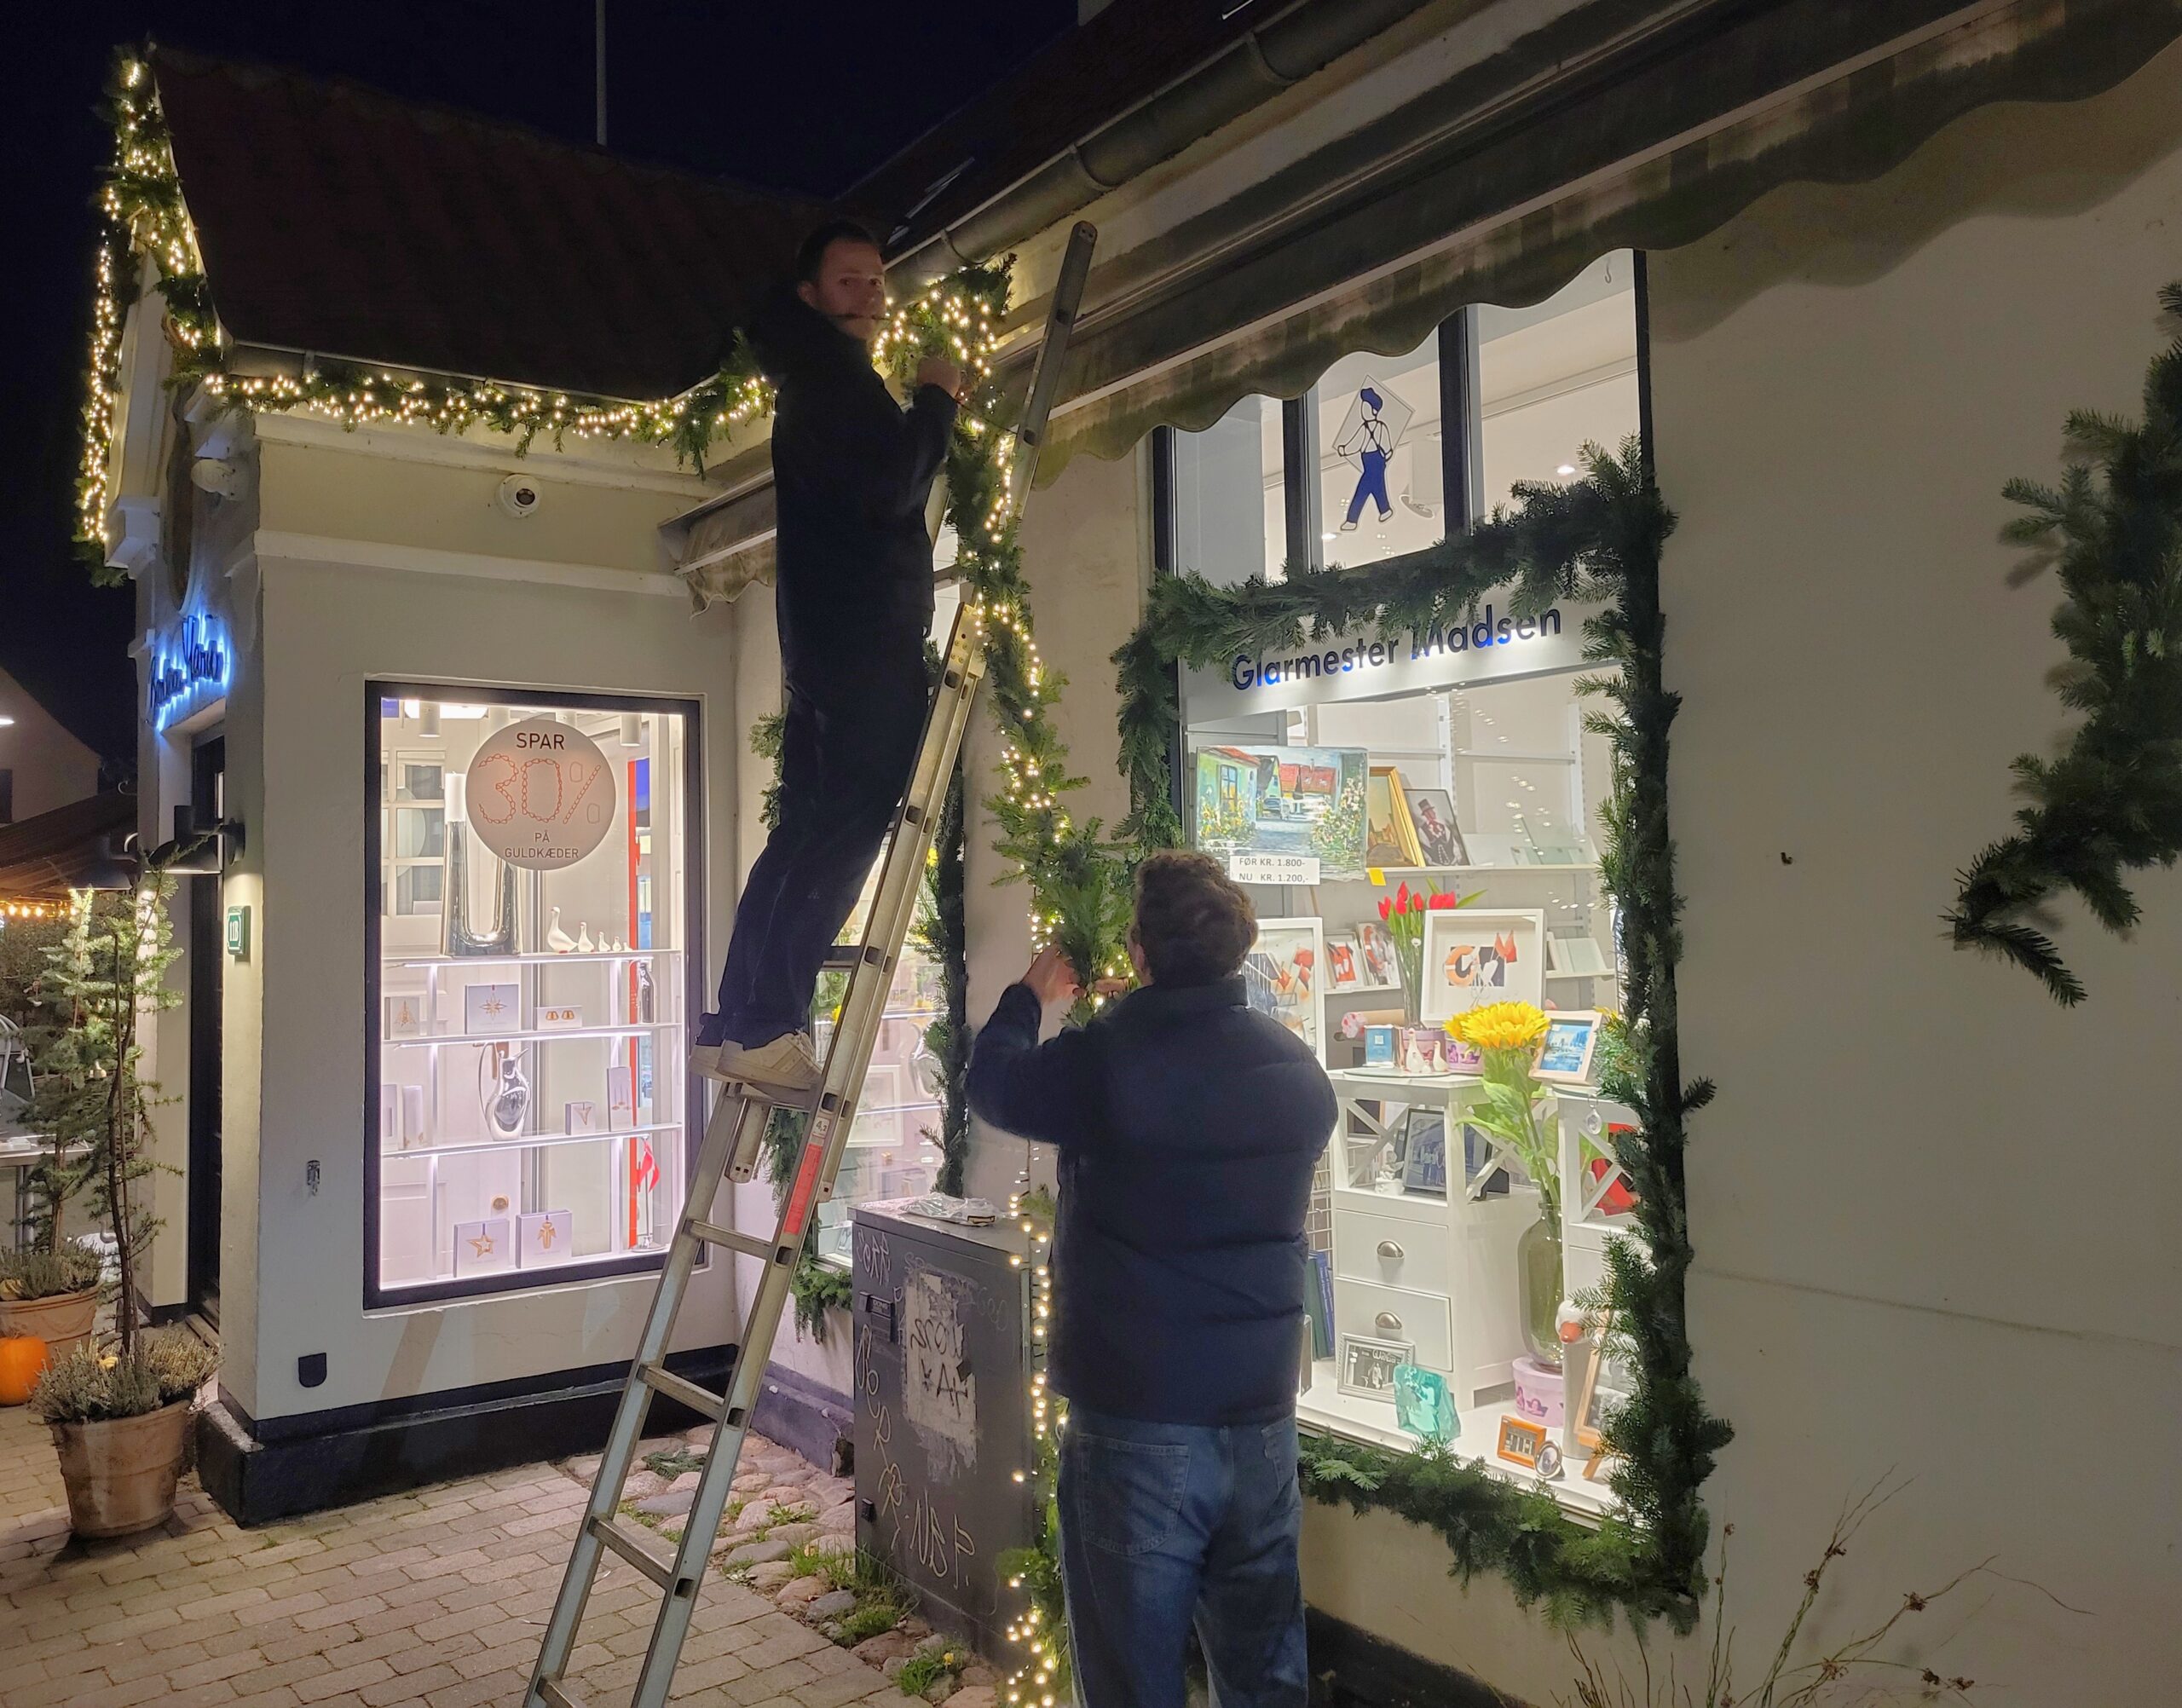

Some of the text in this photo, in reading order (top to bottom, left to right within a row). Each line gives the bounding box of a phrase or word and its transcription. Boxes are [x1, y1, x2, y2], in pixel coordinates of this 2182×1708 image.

[1232, 638, 1399, 690] Glarmester
[516, 732, 565, 750] SPAR
[477, 753, 602, 824] 30%
[534, 829, 551, 843] PÅ
[505, 847, 579, 858] GULDKÆDER
[1239, 857, 1257, 866] FØR
